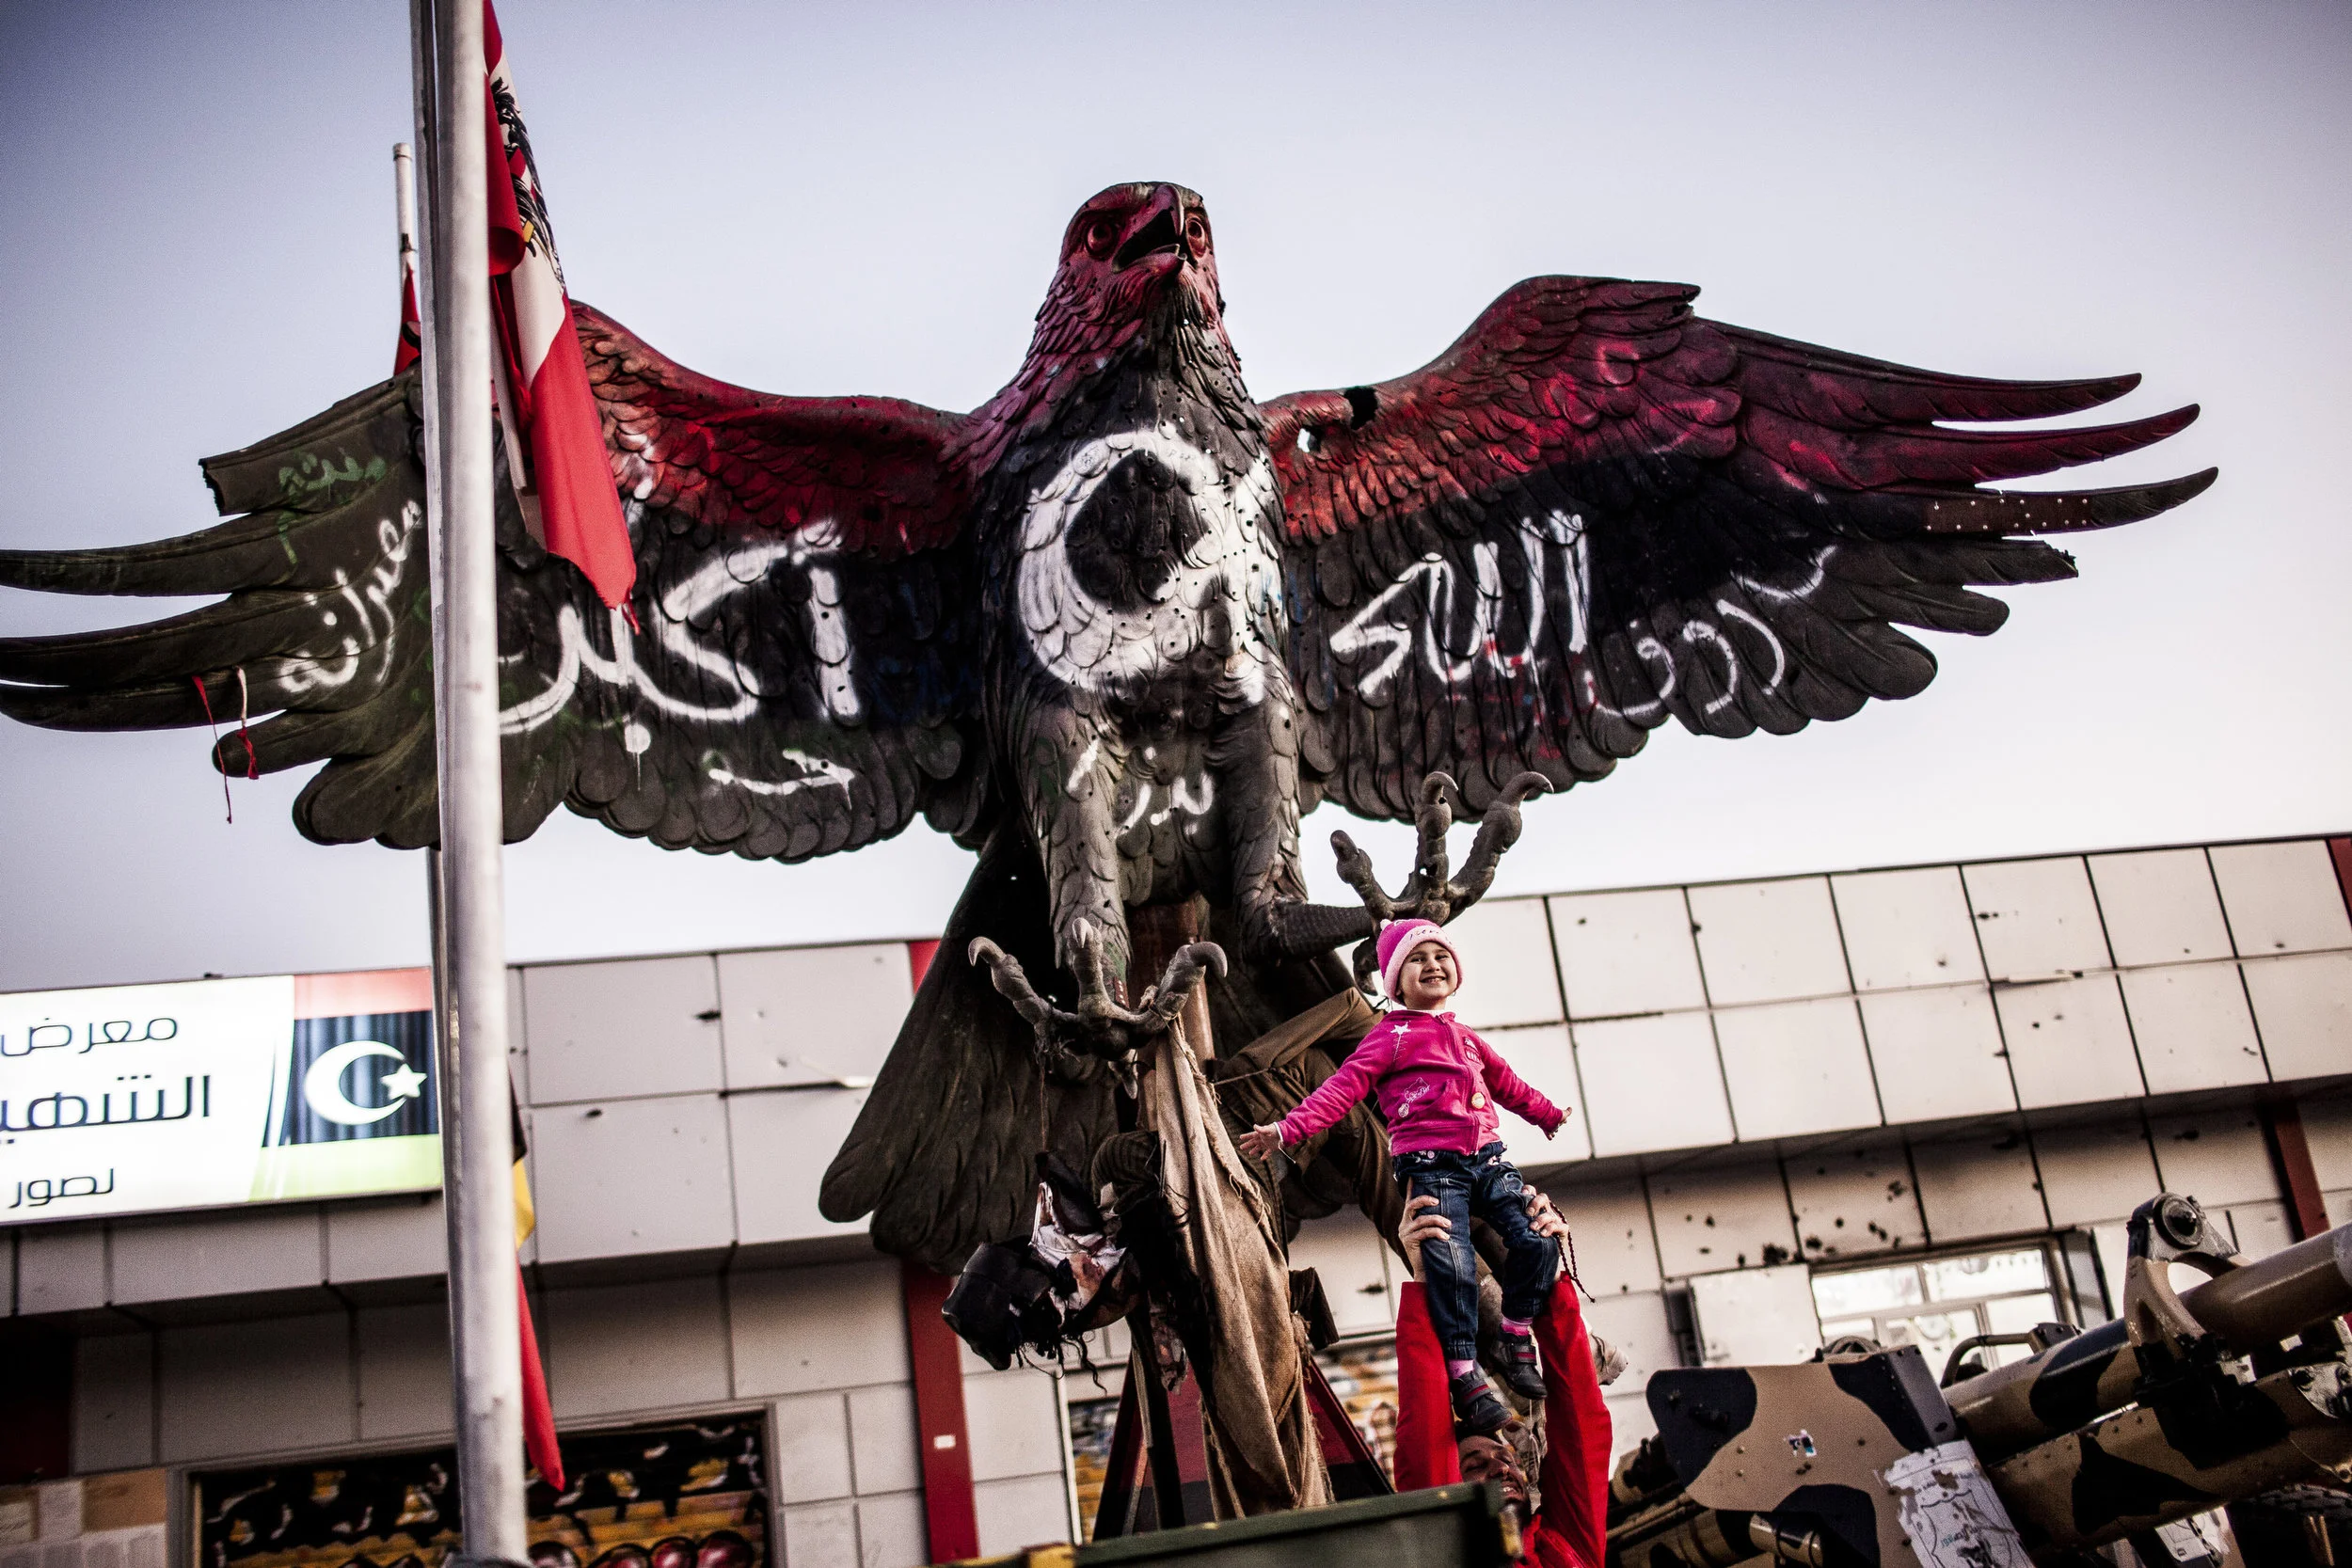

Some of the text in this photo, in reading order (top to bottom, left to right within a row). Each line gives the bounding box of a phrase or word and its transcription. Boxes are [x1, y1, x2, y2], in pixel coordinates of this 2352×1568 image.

[1329, 509, 1591, 701] الله
[1, 1017, 178, 1057] معرض
[0, 1074, 211, 1145] الشهي
[8, 1167, 114, 1209] لصور
